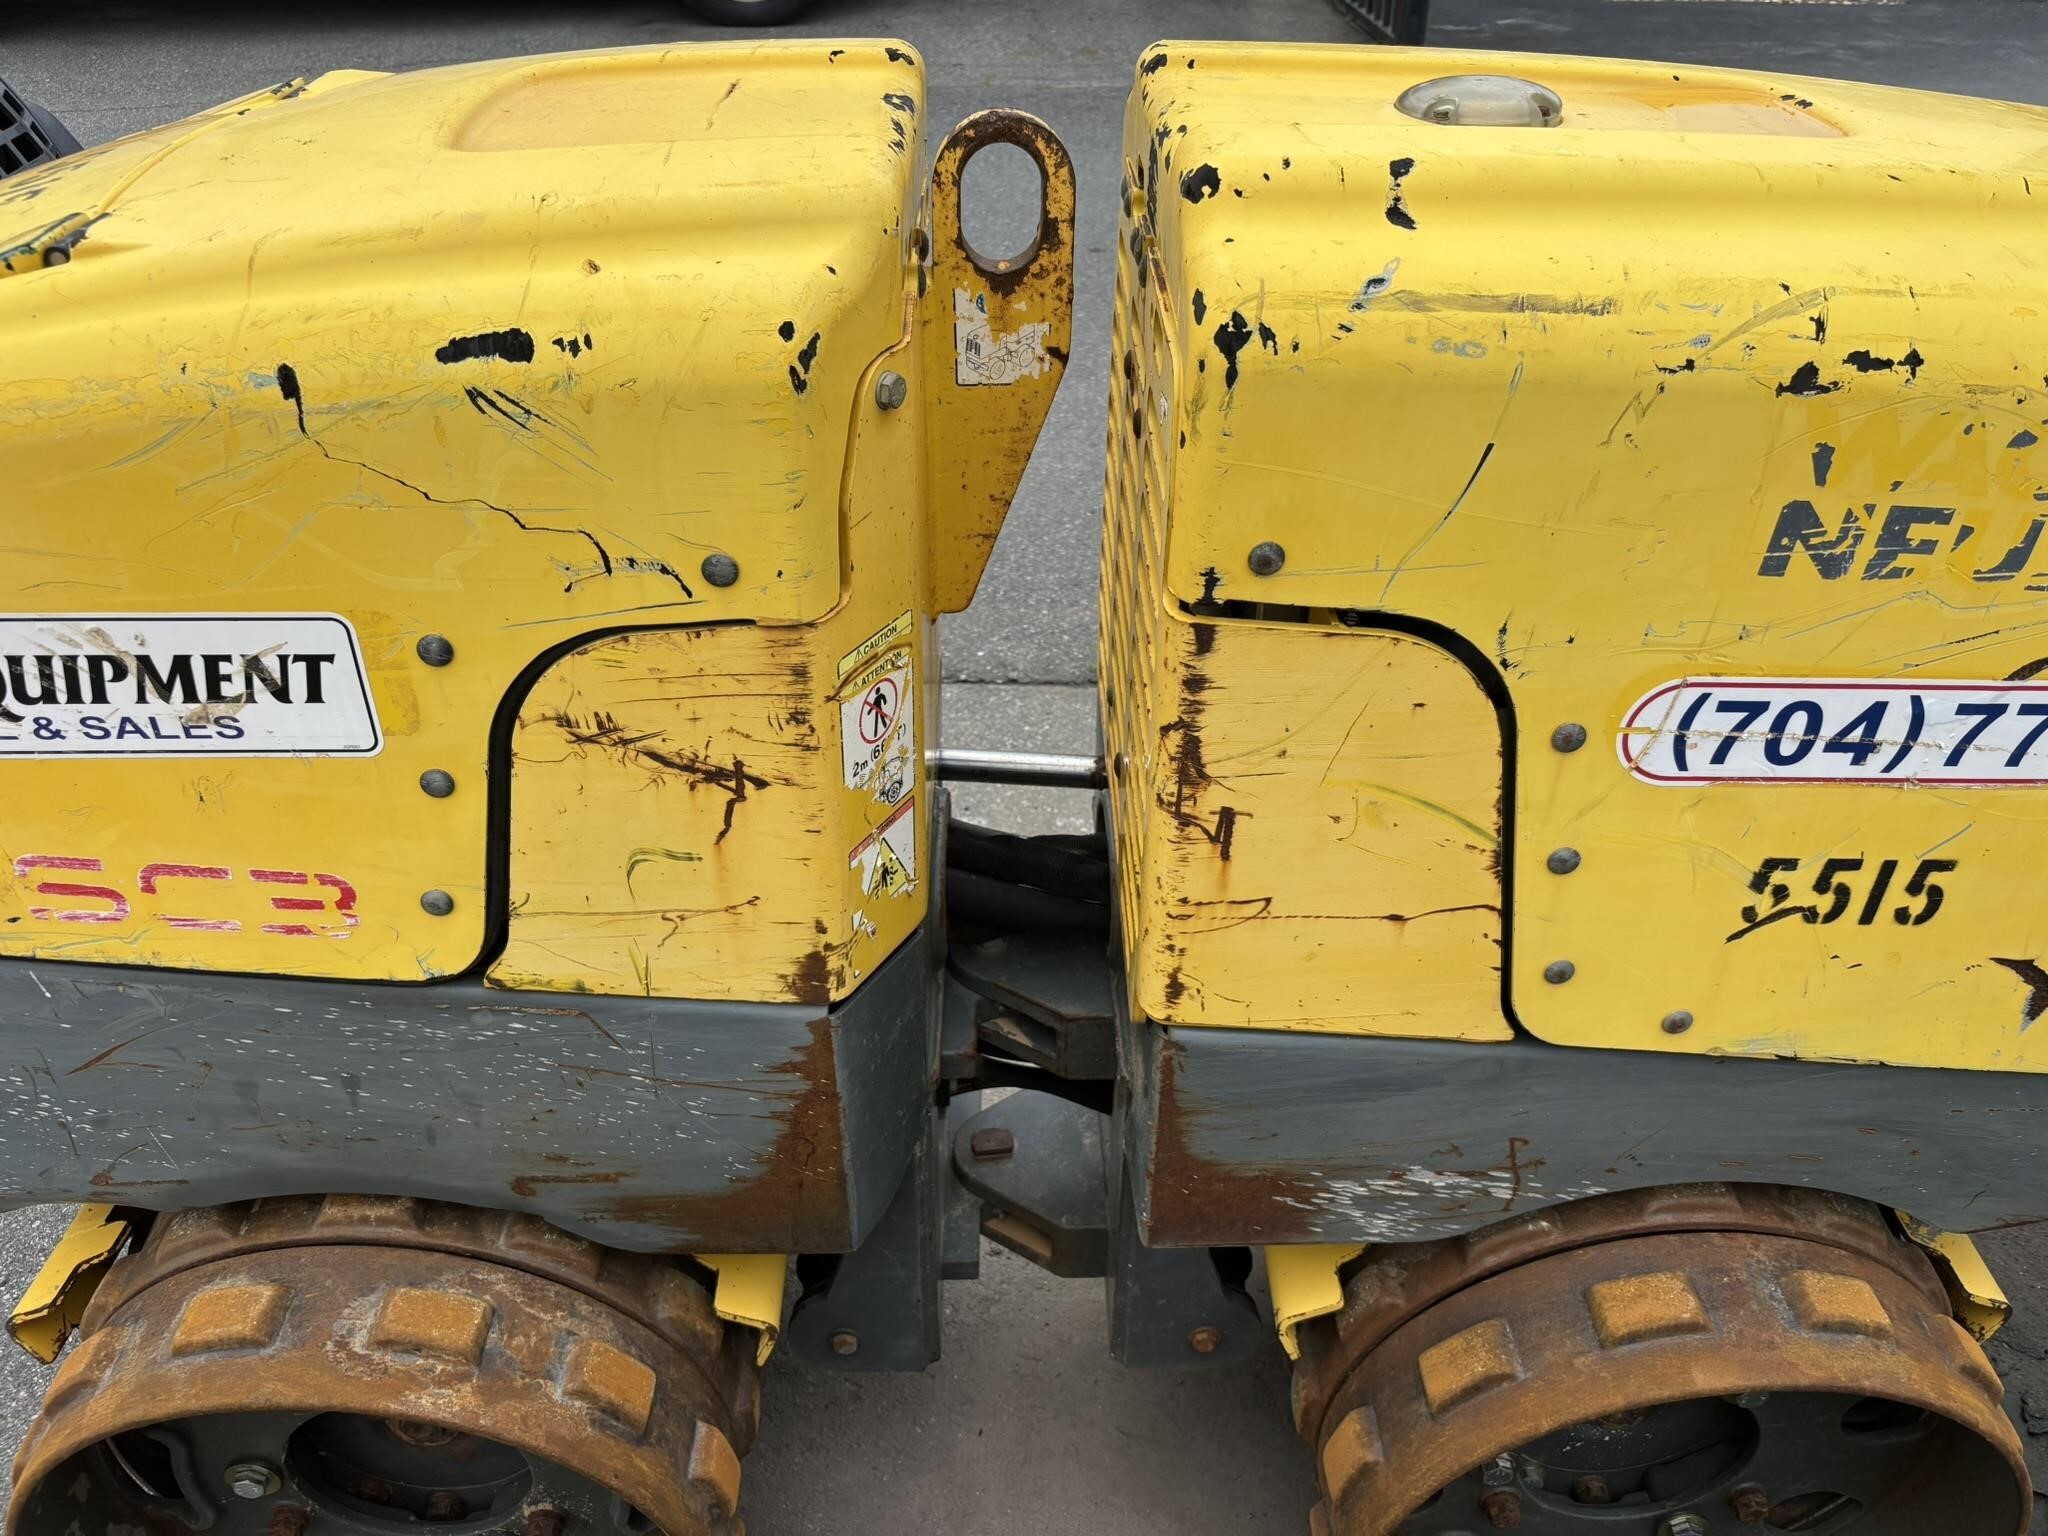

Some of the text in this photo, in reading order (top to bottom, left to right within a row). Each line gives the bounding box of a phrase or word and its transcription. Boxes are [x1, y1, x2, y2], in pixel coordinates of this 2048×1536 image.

[1757, 499, 2048, 592] NEU
[863, 624, 897, 655] CAUTION
[861, 651, 902, 687] ATTENTON
[32, 715, 246, 741] & SALES
[1672, 692, 1926, 774] (704)
[1741, 857, 1959, 926] 5515
